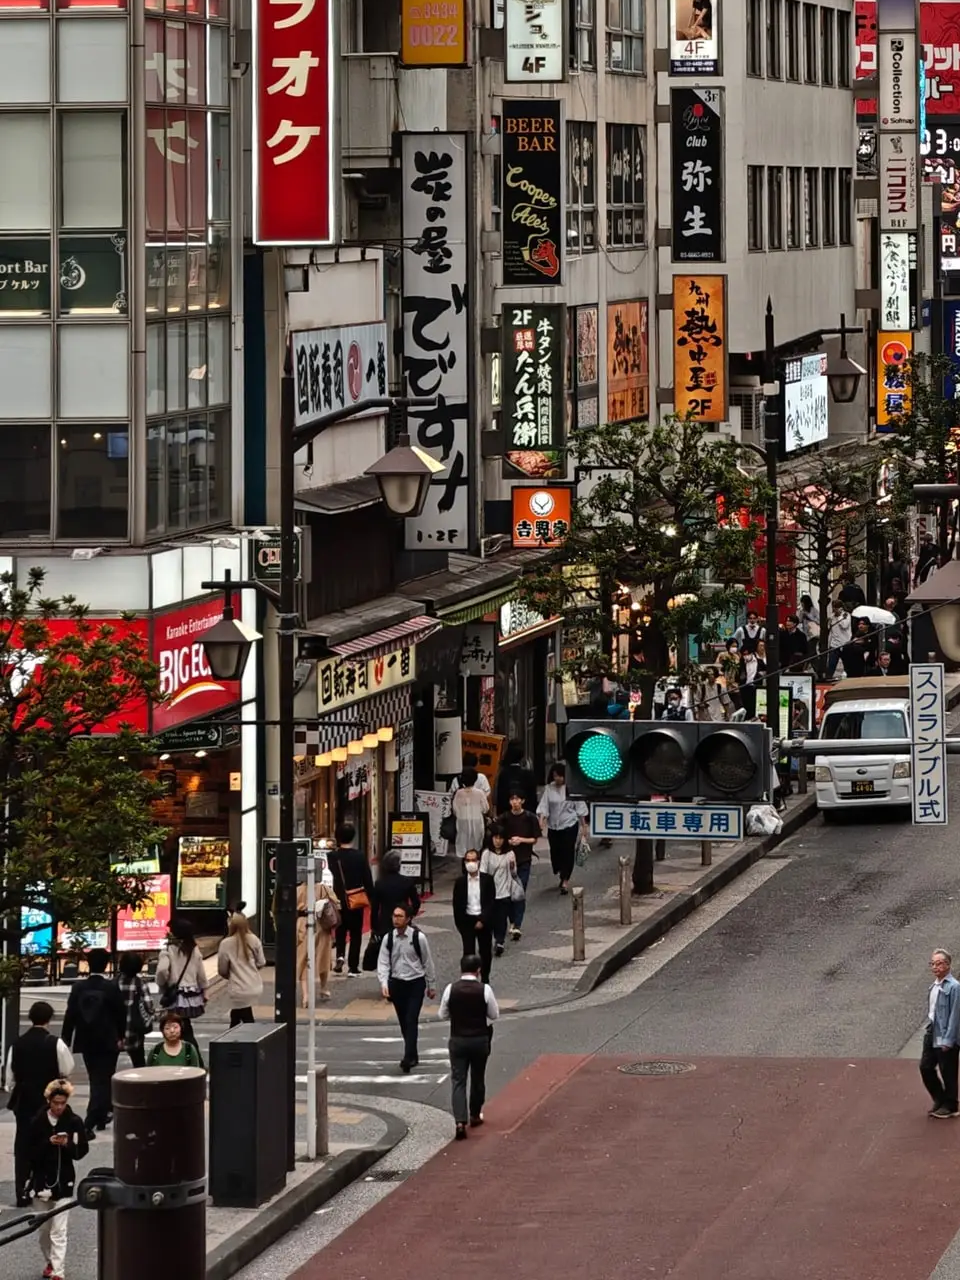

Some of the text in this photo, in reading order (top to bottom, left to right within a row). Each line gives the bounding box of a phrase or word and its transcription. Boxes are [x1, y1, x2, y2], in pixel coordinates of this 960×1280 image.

[424, 3, 458, 18] 3434
[409, 25, 458, 47] 0022
[684, 41, 705, 55] 4F
[522, 56, 546, 74] 4F
[892, 52, 903, 115] Collection
[704, 90, 718, 103] 3F
[506, 118, 556, 133] BEER
[517, 136, 557, 152] BAR
[686, 135, 707, 147] Club
[506, 163, 557, 204] Cooper
[886, 158, 908, 214] ニコラス
[681, 159, 713, 237] 弥生
[24, 260, 48, 273] Bar
[512, 309, 533, 326] 2F
[537, 318, 554, 394] 牛タン焼肉
[512, 350, 537, 447] たん兵衛
[688, 399, 713, 416] 2F
[166, 613, 224, 641] Karaoke Entertainmen
[159, 646, 190, 695] BIG
[917, 672, 942, 819] スクランブル式
[604, 810, 730, 832] 自転車専用
